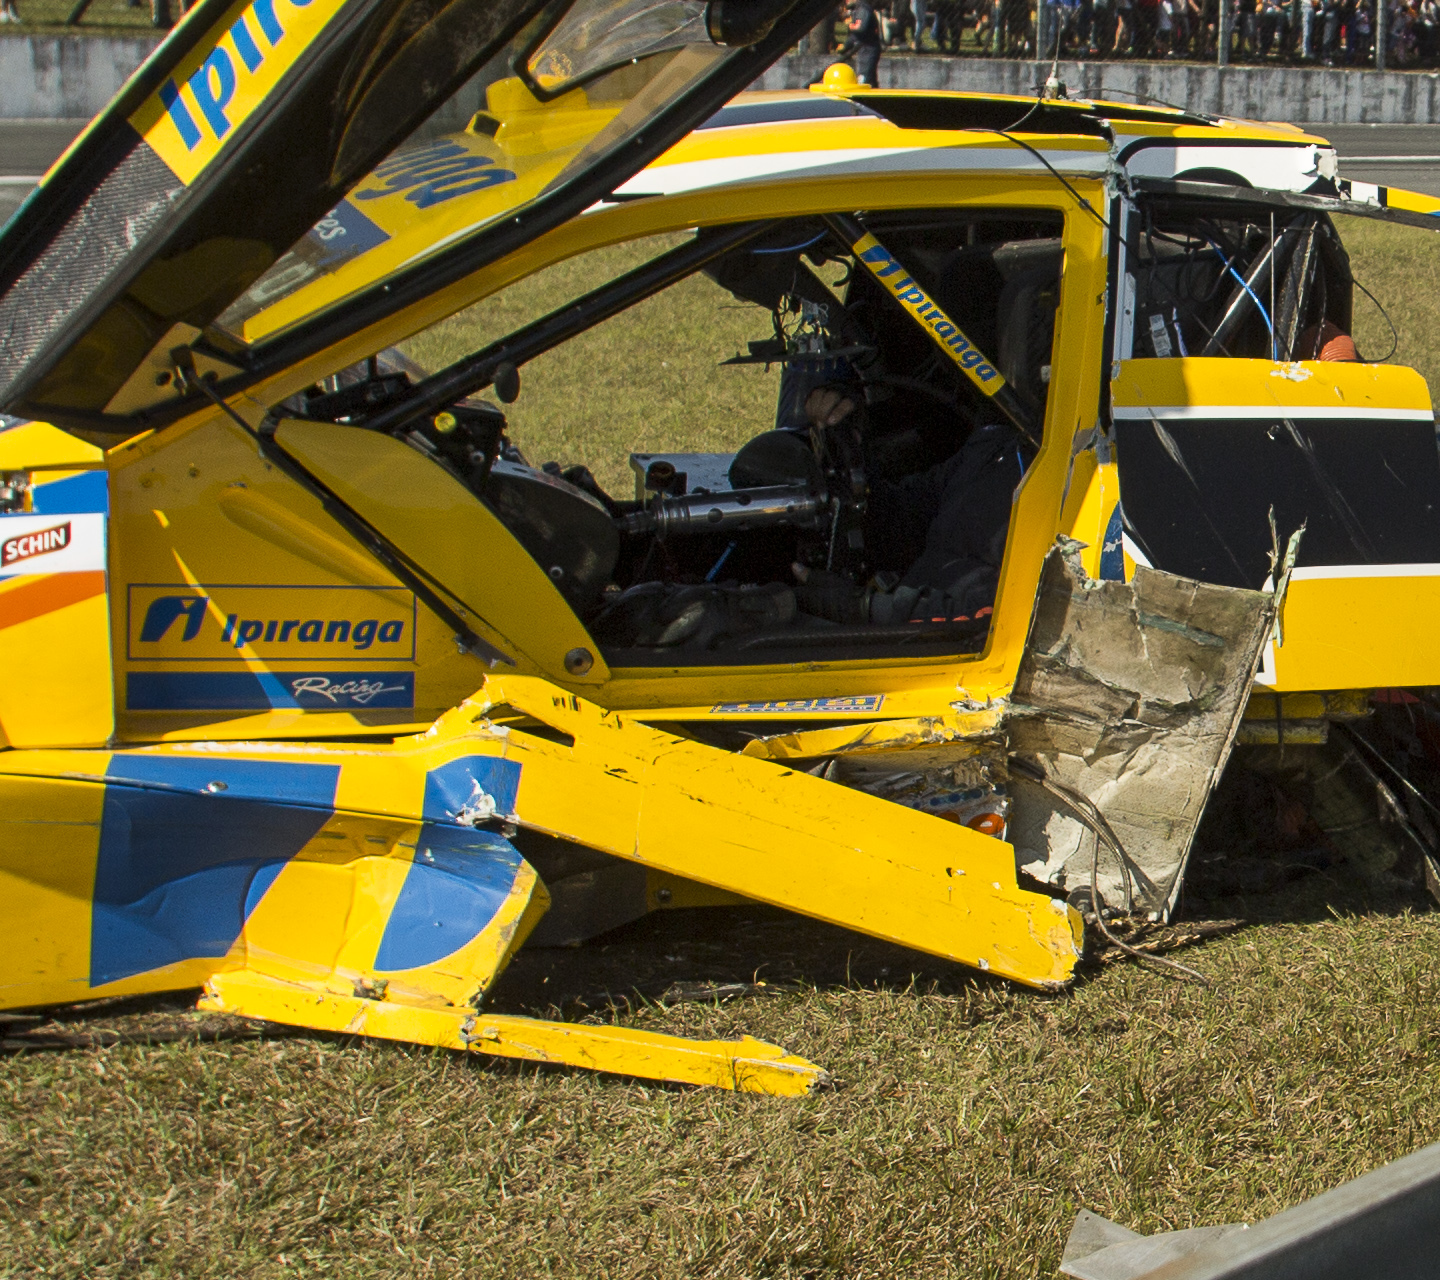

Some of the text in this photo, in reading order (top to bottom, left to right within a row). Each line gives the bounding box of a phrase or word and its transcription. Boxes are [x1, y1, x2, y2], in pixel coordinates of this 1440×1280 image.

[893, 276, 997, 382] Ipiranga
[5, 527, 65, 561] SCHIN
[220, 613, 405, 650] Ipiranga
[292, 676, 405, 704] Racing
